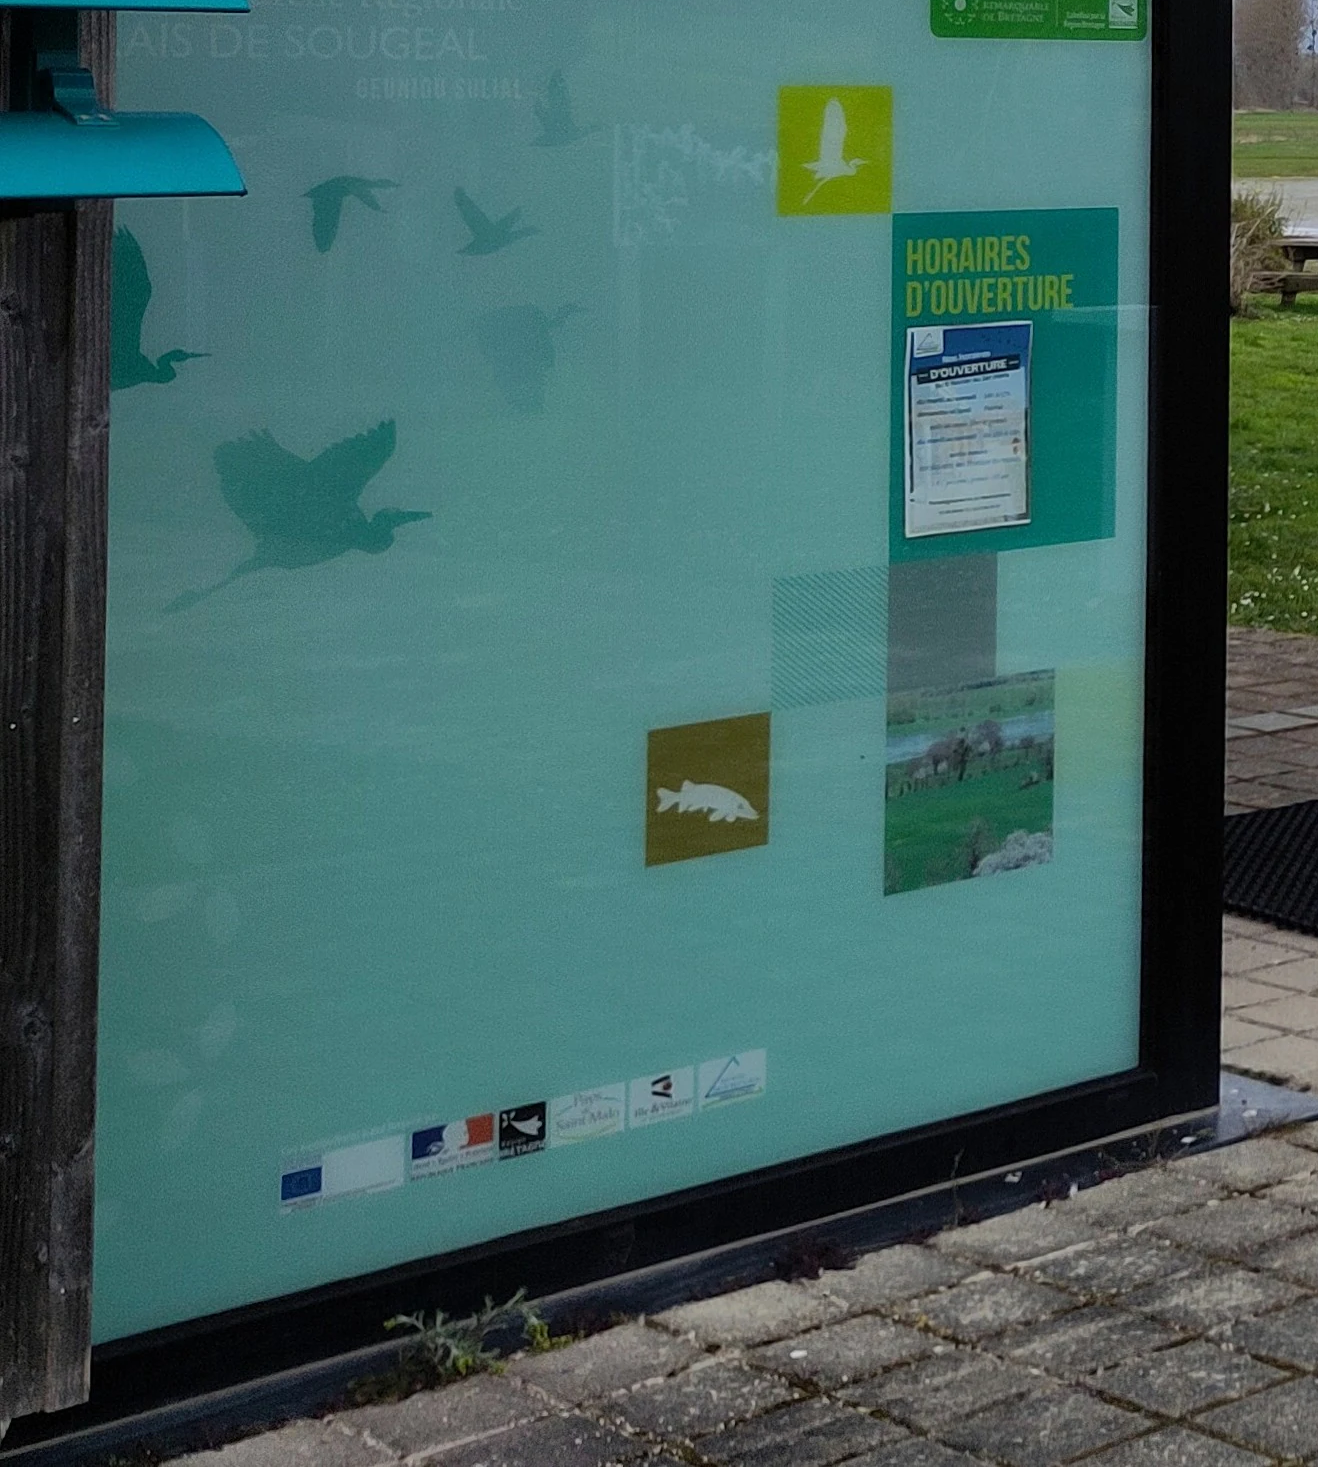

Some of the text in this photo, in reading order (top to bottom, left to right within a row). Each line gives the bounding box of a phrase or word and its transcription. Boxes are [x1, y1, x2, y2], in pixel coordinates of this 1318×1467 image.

[115, 24, 193, 59] AIS
[209, 24, 270, 59] DE
[906, 235, 1031, 275] HORAIRES
[906, 273, 1075, 318] D'OUVERTURE
[929, 359, 1007, 380] D'OUVERTURE
